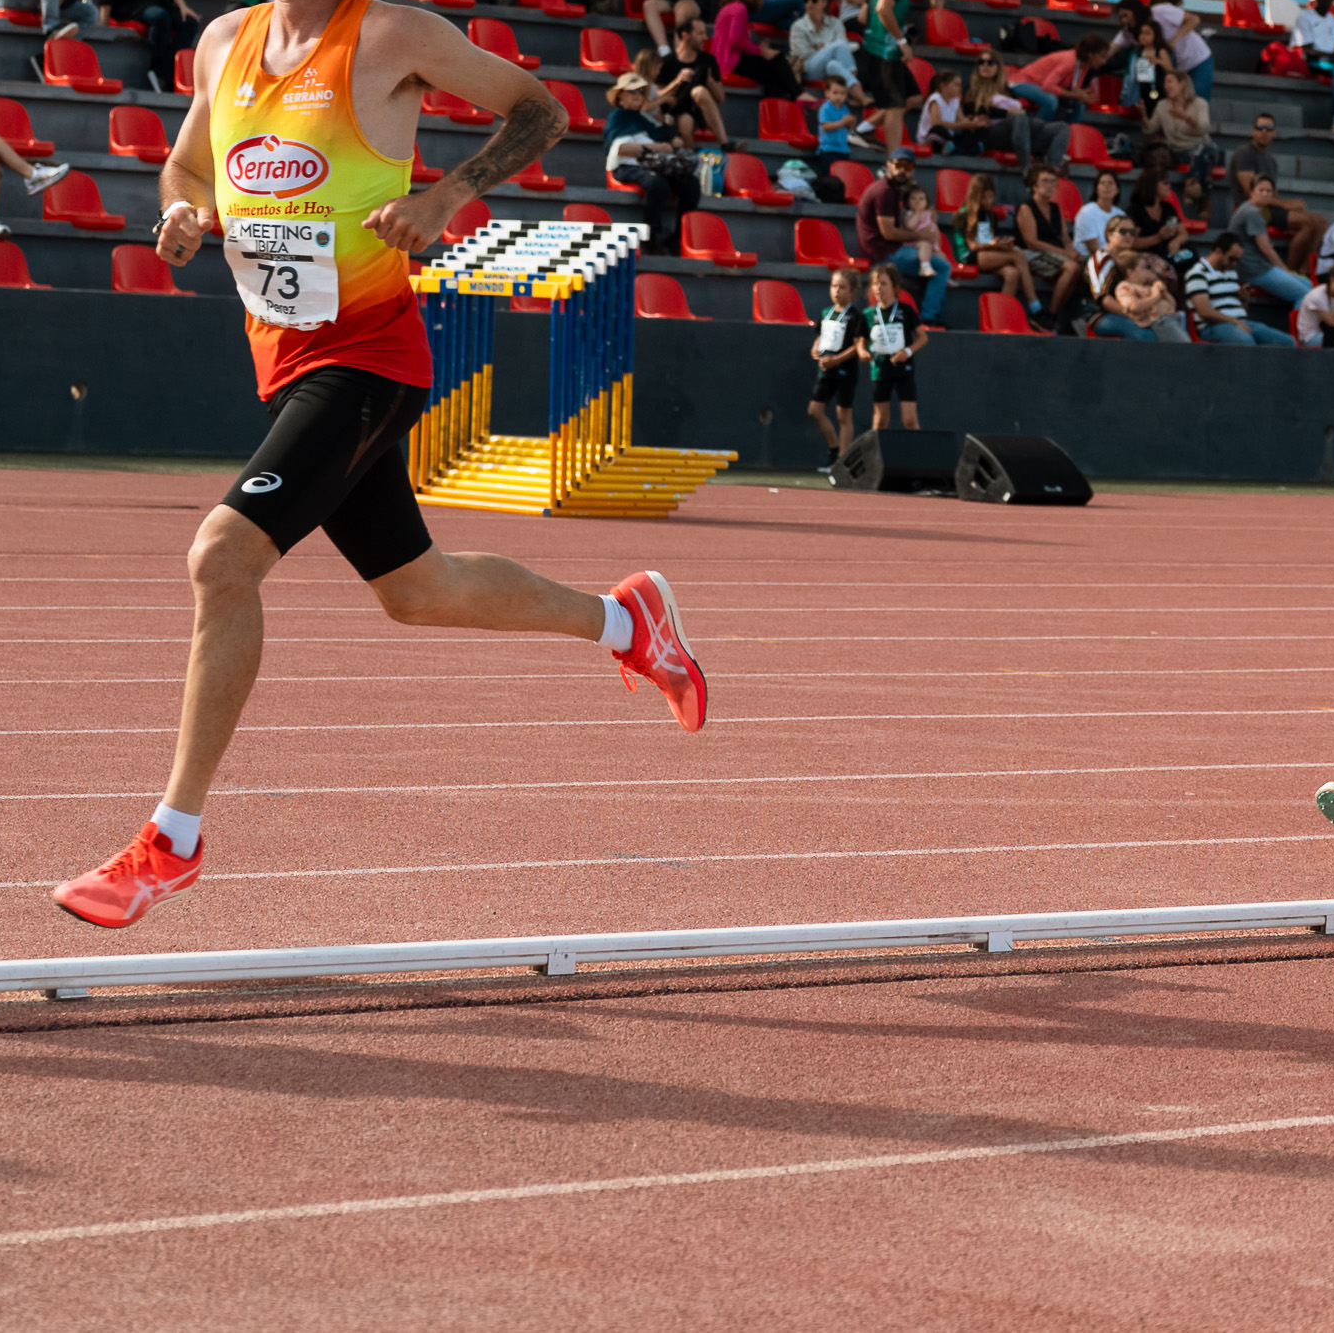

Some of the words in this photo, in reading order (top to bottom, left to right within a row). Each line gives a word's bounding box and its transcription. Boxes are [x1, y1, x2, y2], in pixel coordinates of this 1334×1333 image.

[282, 90, 334, 104] SERRANO
[234, 153, 318, 180] Serrano
[227, 203, 282, 217] Alimentos
[285, 201, 300, 215] de
[302, 201, 335, 218] Hoy
[240, 223, 313, 241] MEETING
[255, 240, 289, 254] IBIZA
[257, 263, 300, 300] 73
[469, 282, 505, 292] MONDO
[266, 299, 297, 315] Perez
